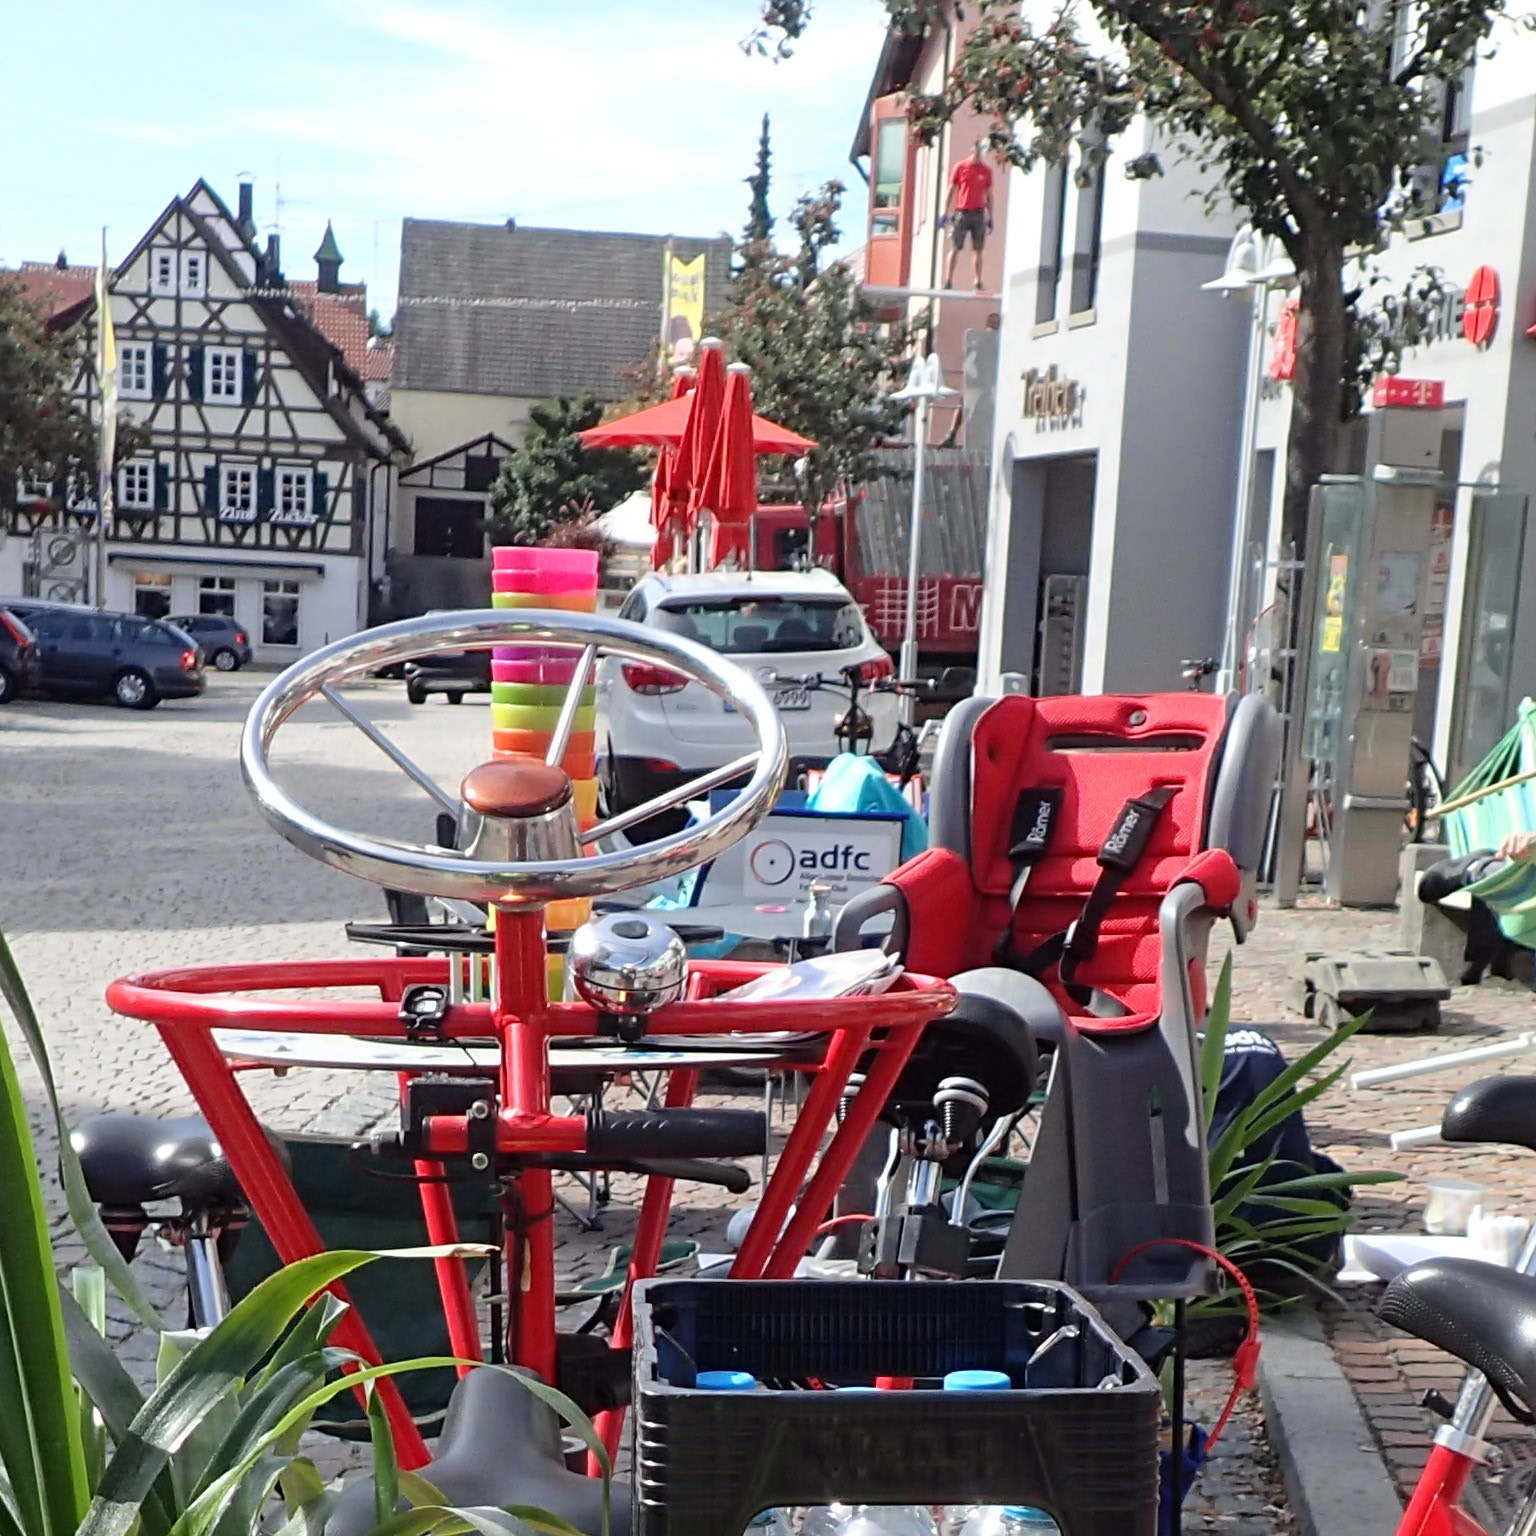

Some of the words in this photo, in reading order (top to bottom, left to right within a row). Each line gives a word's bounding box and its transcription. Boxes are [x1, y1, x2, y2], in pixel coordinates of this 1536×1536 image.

[1026, 801, 1052, 842] Römer
[1104, 809, 1141, 854] Römer
[799, 845, 871, 870] adfc
